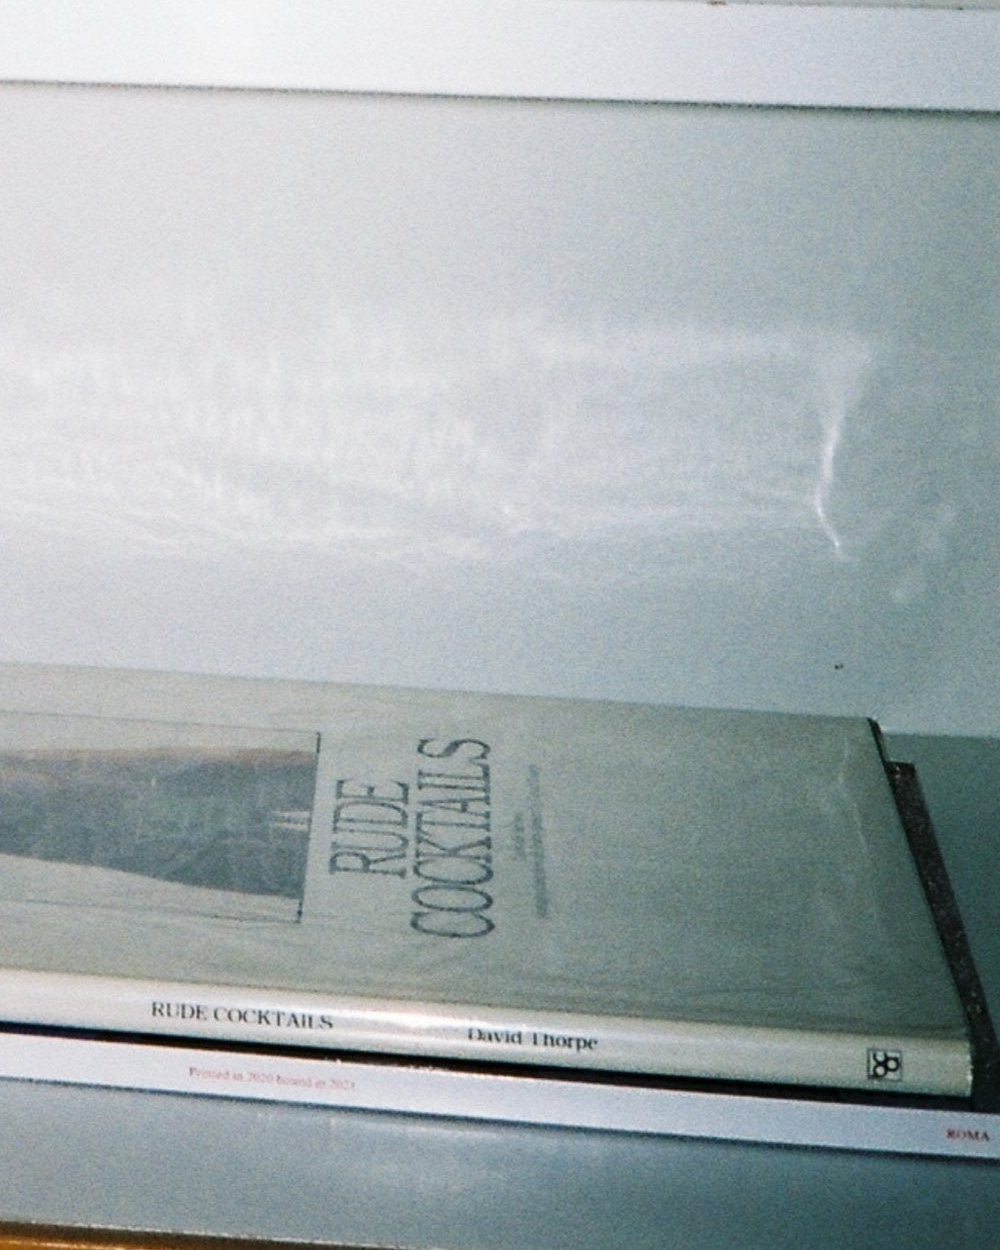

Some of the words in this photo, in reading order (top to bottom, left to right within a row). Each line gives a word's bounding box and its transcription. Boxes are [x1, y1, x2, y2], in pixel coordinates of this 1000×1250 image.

[328, 779, 410, 880] RUDE
[409, 737, 495, 940] COCKTAILS
[151, 1001, 207, 1021] RUDE
[213, 1006, 334, 1030] COCKTAILS
[467, 1028, 523, 1045] David
[531, 1031, 599, 1052] Thorpe
[945, 1128, 991, 1142] ROMA
